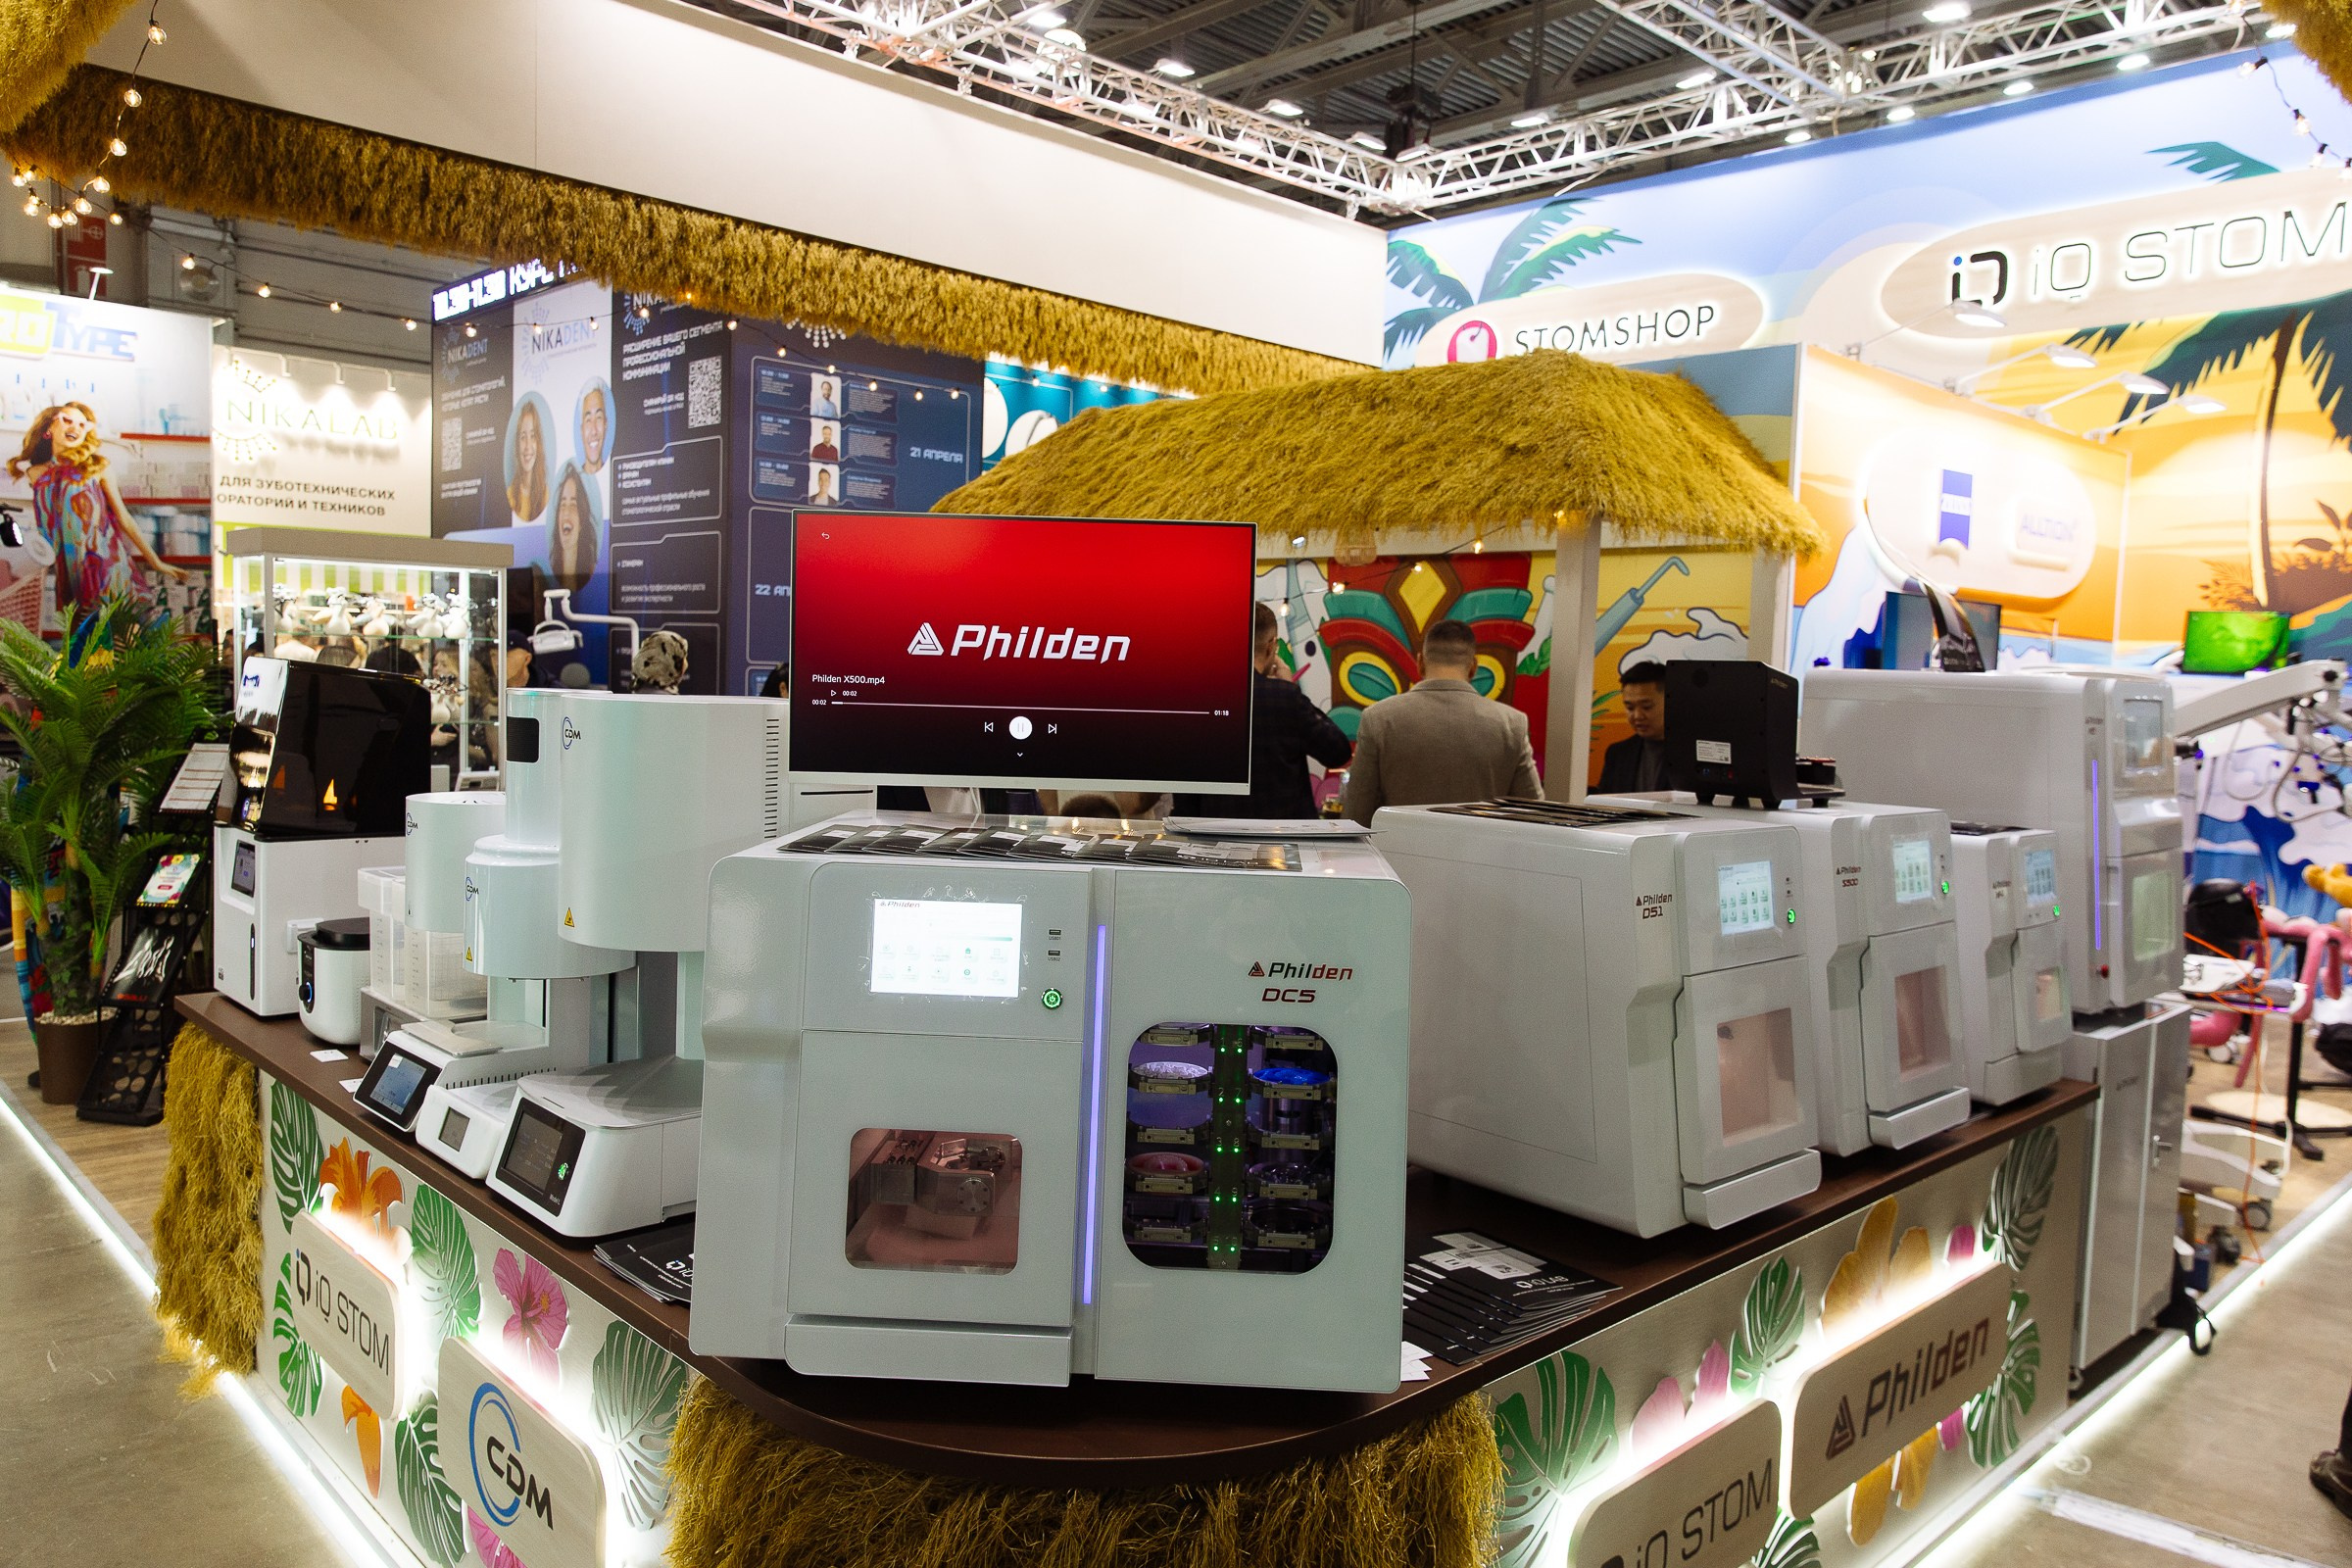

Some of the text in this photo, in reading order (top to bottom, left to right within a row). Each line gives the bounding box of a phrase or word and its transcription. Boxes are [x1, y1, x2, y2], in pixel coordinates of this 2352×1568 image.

[2125, 202, 2347, 282] STOM
[1514, 304, 1716, 353] STOMSHOP
[448, 338, 488, 364] NIKADENT
[227, 400, 397, 440] NIKALAB
[909, 447, 963, 464] 21 АПРЕЛЯ
[220, 475, 395, 501] ДЛЯ ЗУБОТЕХНИЧЕСКИХ
[217, 493, 385, 516] ОРАТОРИЙ И ТЕХНИКОВ
[755, 584, 771, 596] 22
[950, 623, 1131, 664] Philden
[811, 674, 886, 686] Philden X500.mp4
[564, 728, 581, 740] CDM
[408, 820, 418, 829] CDM
[466, 885, 479, 895] CDM
[1643, 893, 1673, 906] Philden
[1642, 906, 1663, 919] D51
[1268, 961, 1353, 981] Philden
[1261, 988, 1316, 1004] DC5
[337, 1300, 390, 1377] STOM
[1861, 1318, 1989, 1439] Philden
[486, 1435, 554, 1531] CDM
[1681, 1458, 1773, 1561] STOM
